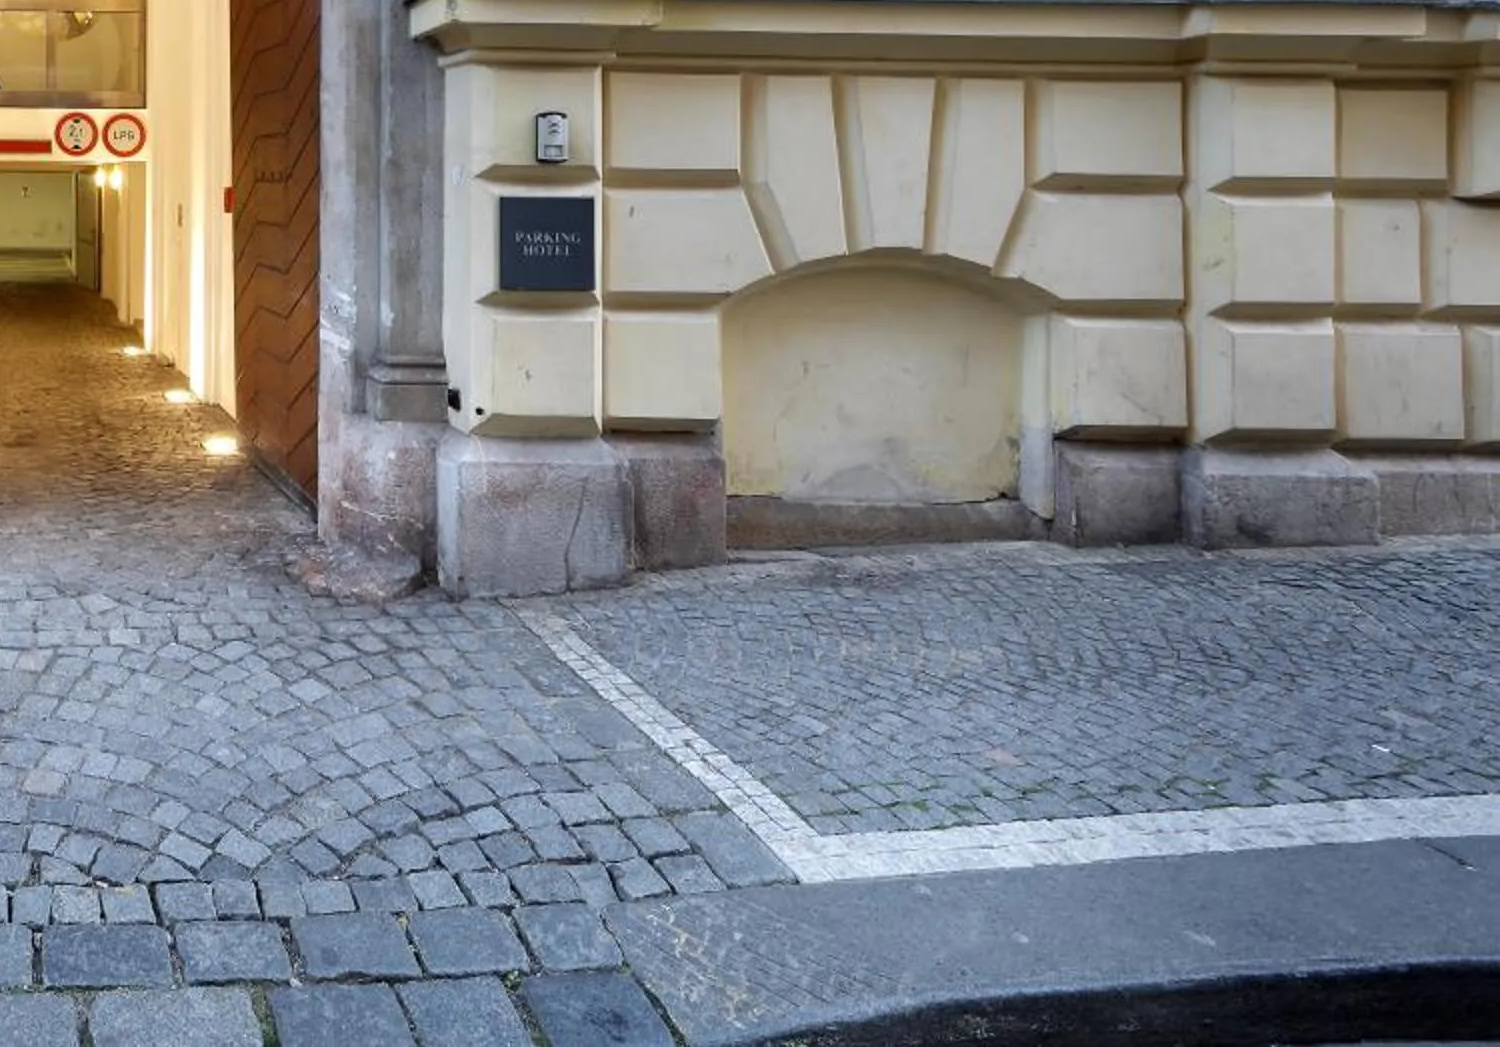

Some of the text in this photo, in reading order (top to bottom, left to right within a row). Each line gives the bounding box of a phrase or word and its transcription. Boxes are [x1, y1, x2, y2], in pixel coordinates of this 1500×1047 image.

[113, 130, 135, 140] LPG
[515, 232, 581, 243] PARKING
[523, 244, 570, 256] HOTEL
